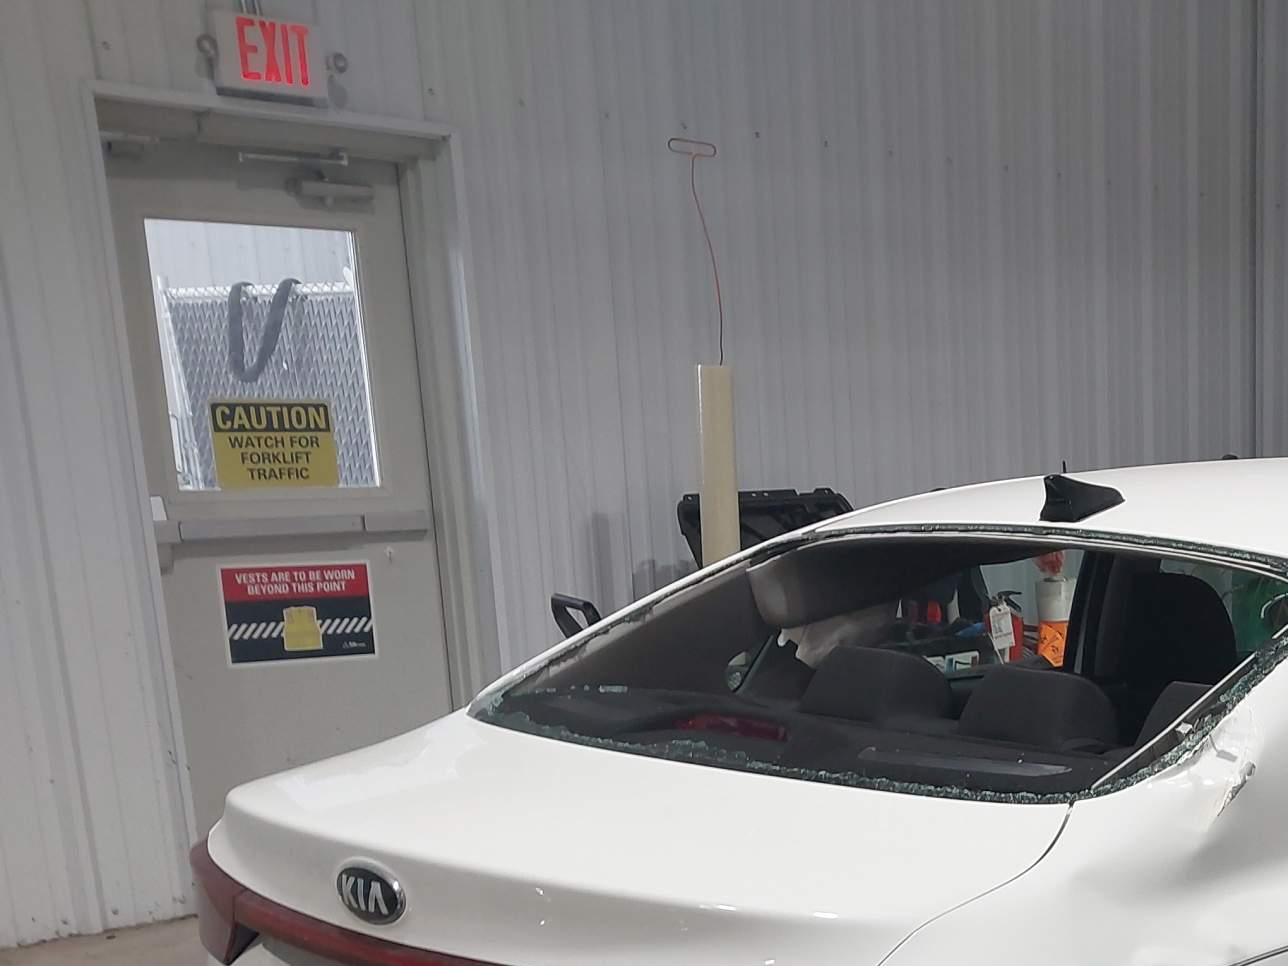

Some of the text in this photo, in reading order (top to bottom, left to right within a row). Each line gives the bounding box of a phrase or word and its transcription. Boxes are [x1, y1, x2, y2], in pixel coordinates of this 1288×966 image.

[235, 16, 309, 86] EXIT
[215, 406, 327, 430] CAUTION
[229, 435, 320, 448] WATCH FOR
[240, 451, 312, 465] FORKLIFT
[247, 467, 310, 480] TRAFFIC
[235, 569, 355, 584] VESTS ARE TO BE WORN
[247, 581, 346, 596] BEYOND THIS POINT
[342, 873, 389, 915] KIA
